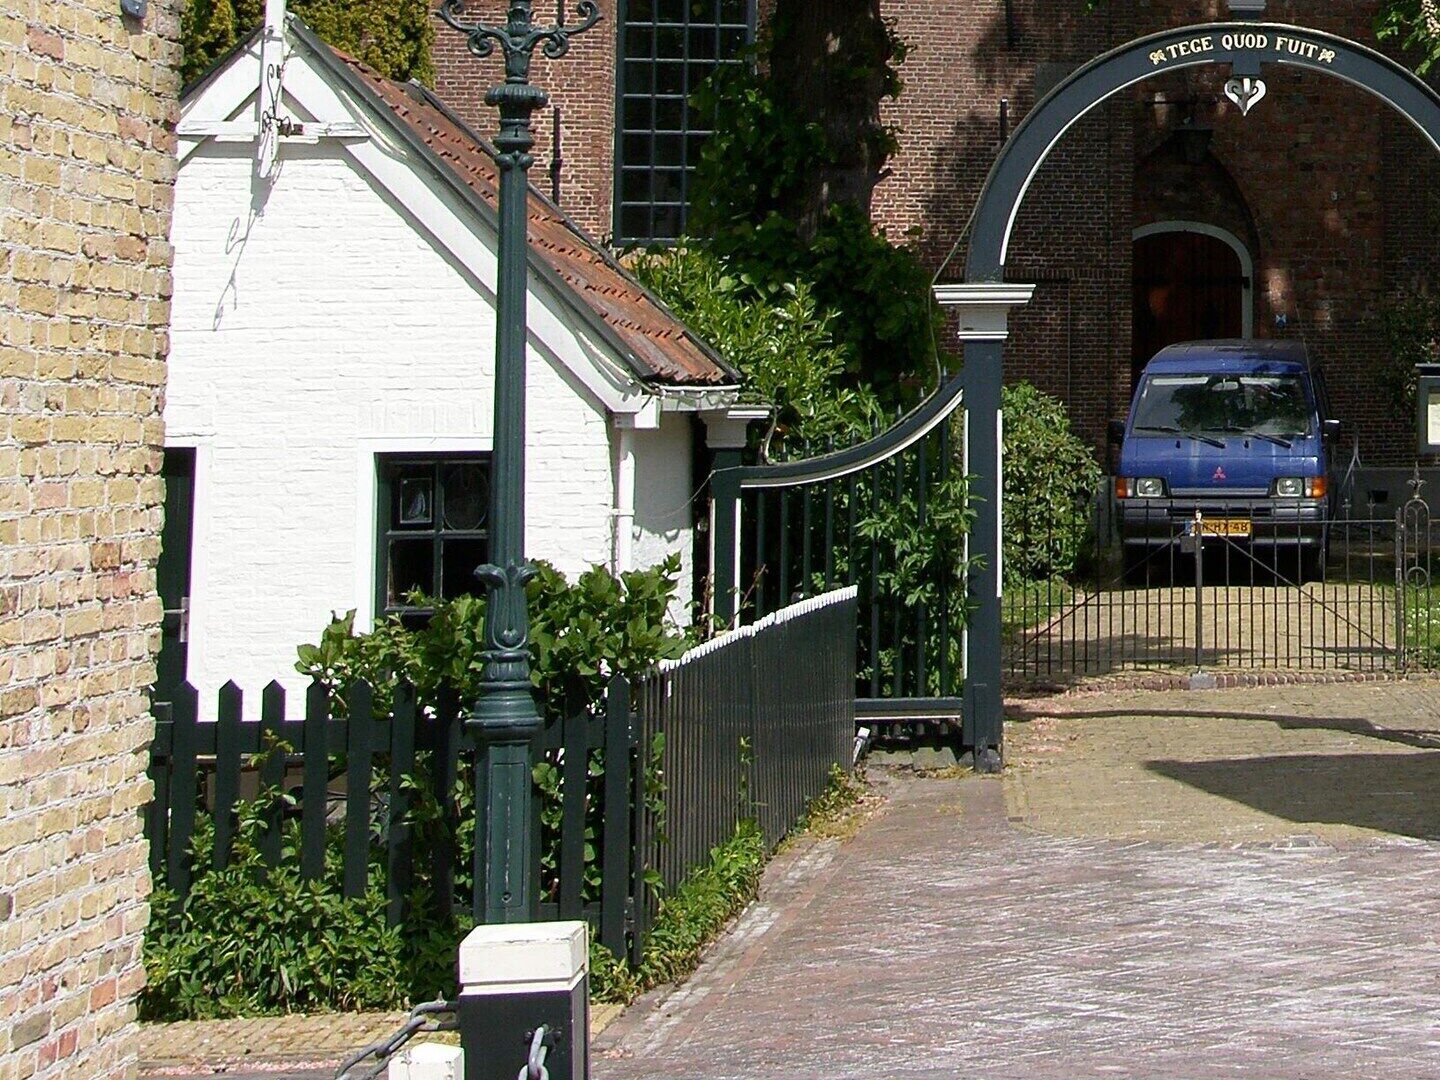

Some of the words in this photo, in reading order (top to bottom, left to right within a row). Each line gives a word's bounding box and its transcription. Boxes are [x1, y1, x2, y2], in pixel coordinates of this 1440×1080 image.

[1166, 36, 1214, 59] TEGE
[1221, 33, 1268, 51] QUOD
[1275, 36, 1319, 59] FUIT
